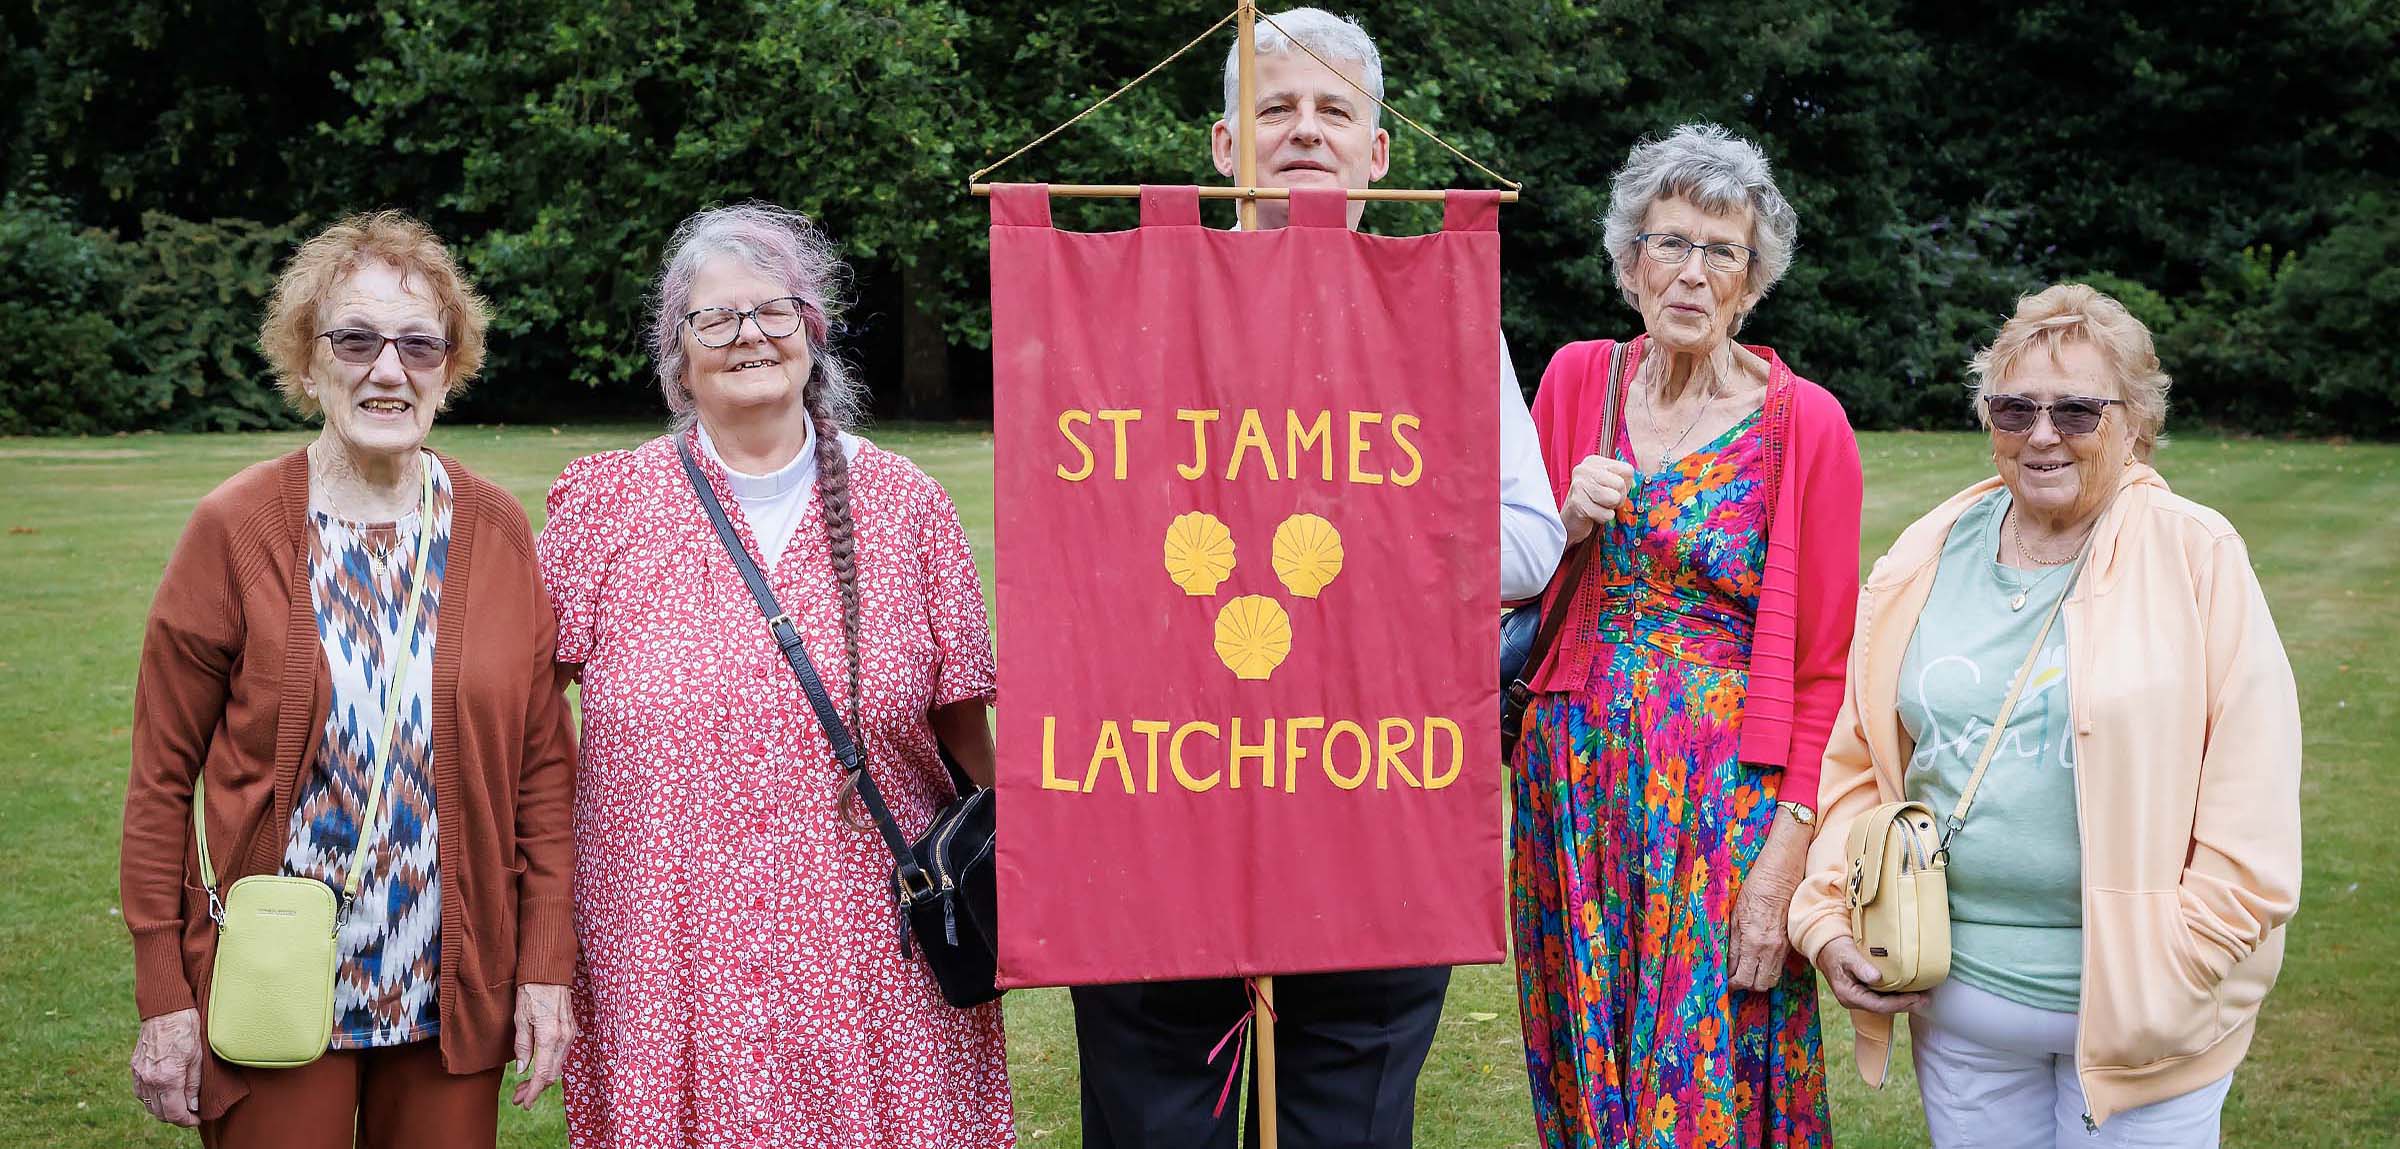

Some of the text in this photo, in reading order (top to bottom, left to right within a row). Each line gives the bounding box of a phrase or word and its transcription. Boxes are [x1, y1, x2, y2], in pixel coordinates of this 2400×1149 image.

[1057, 408, 1423, 486] ST JAMES
[1041, 716, 1464, 793] LATCHFORD
